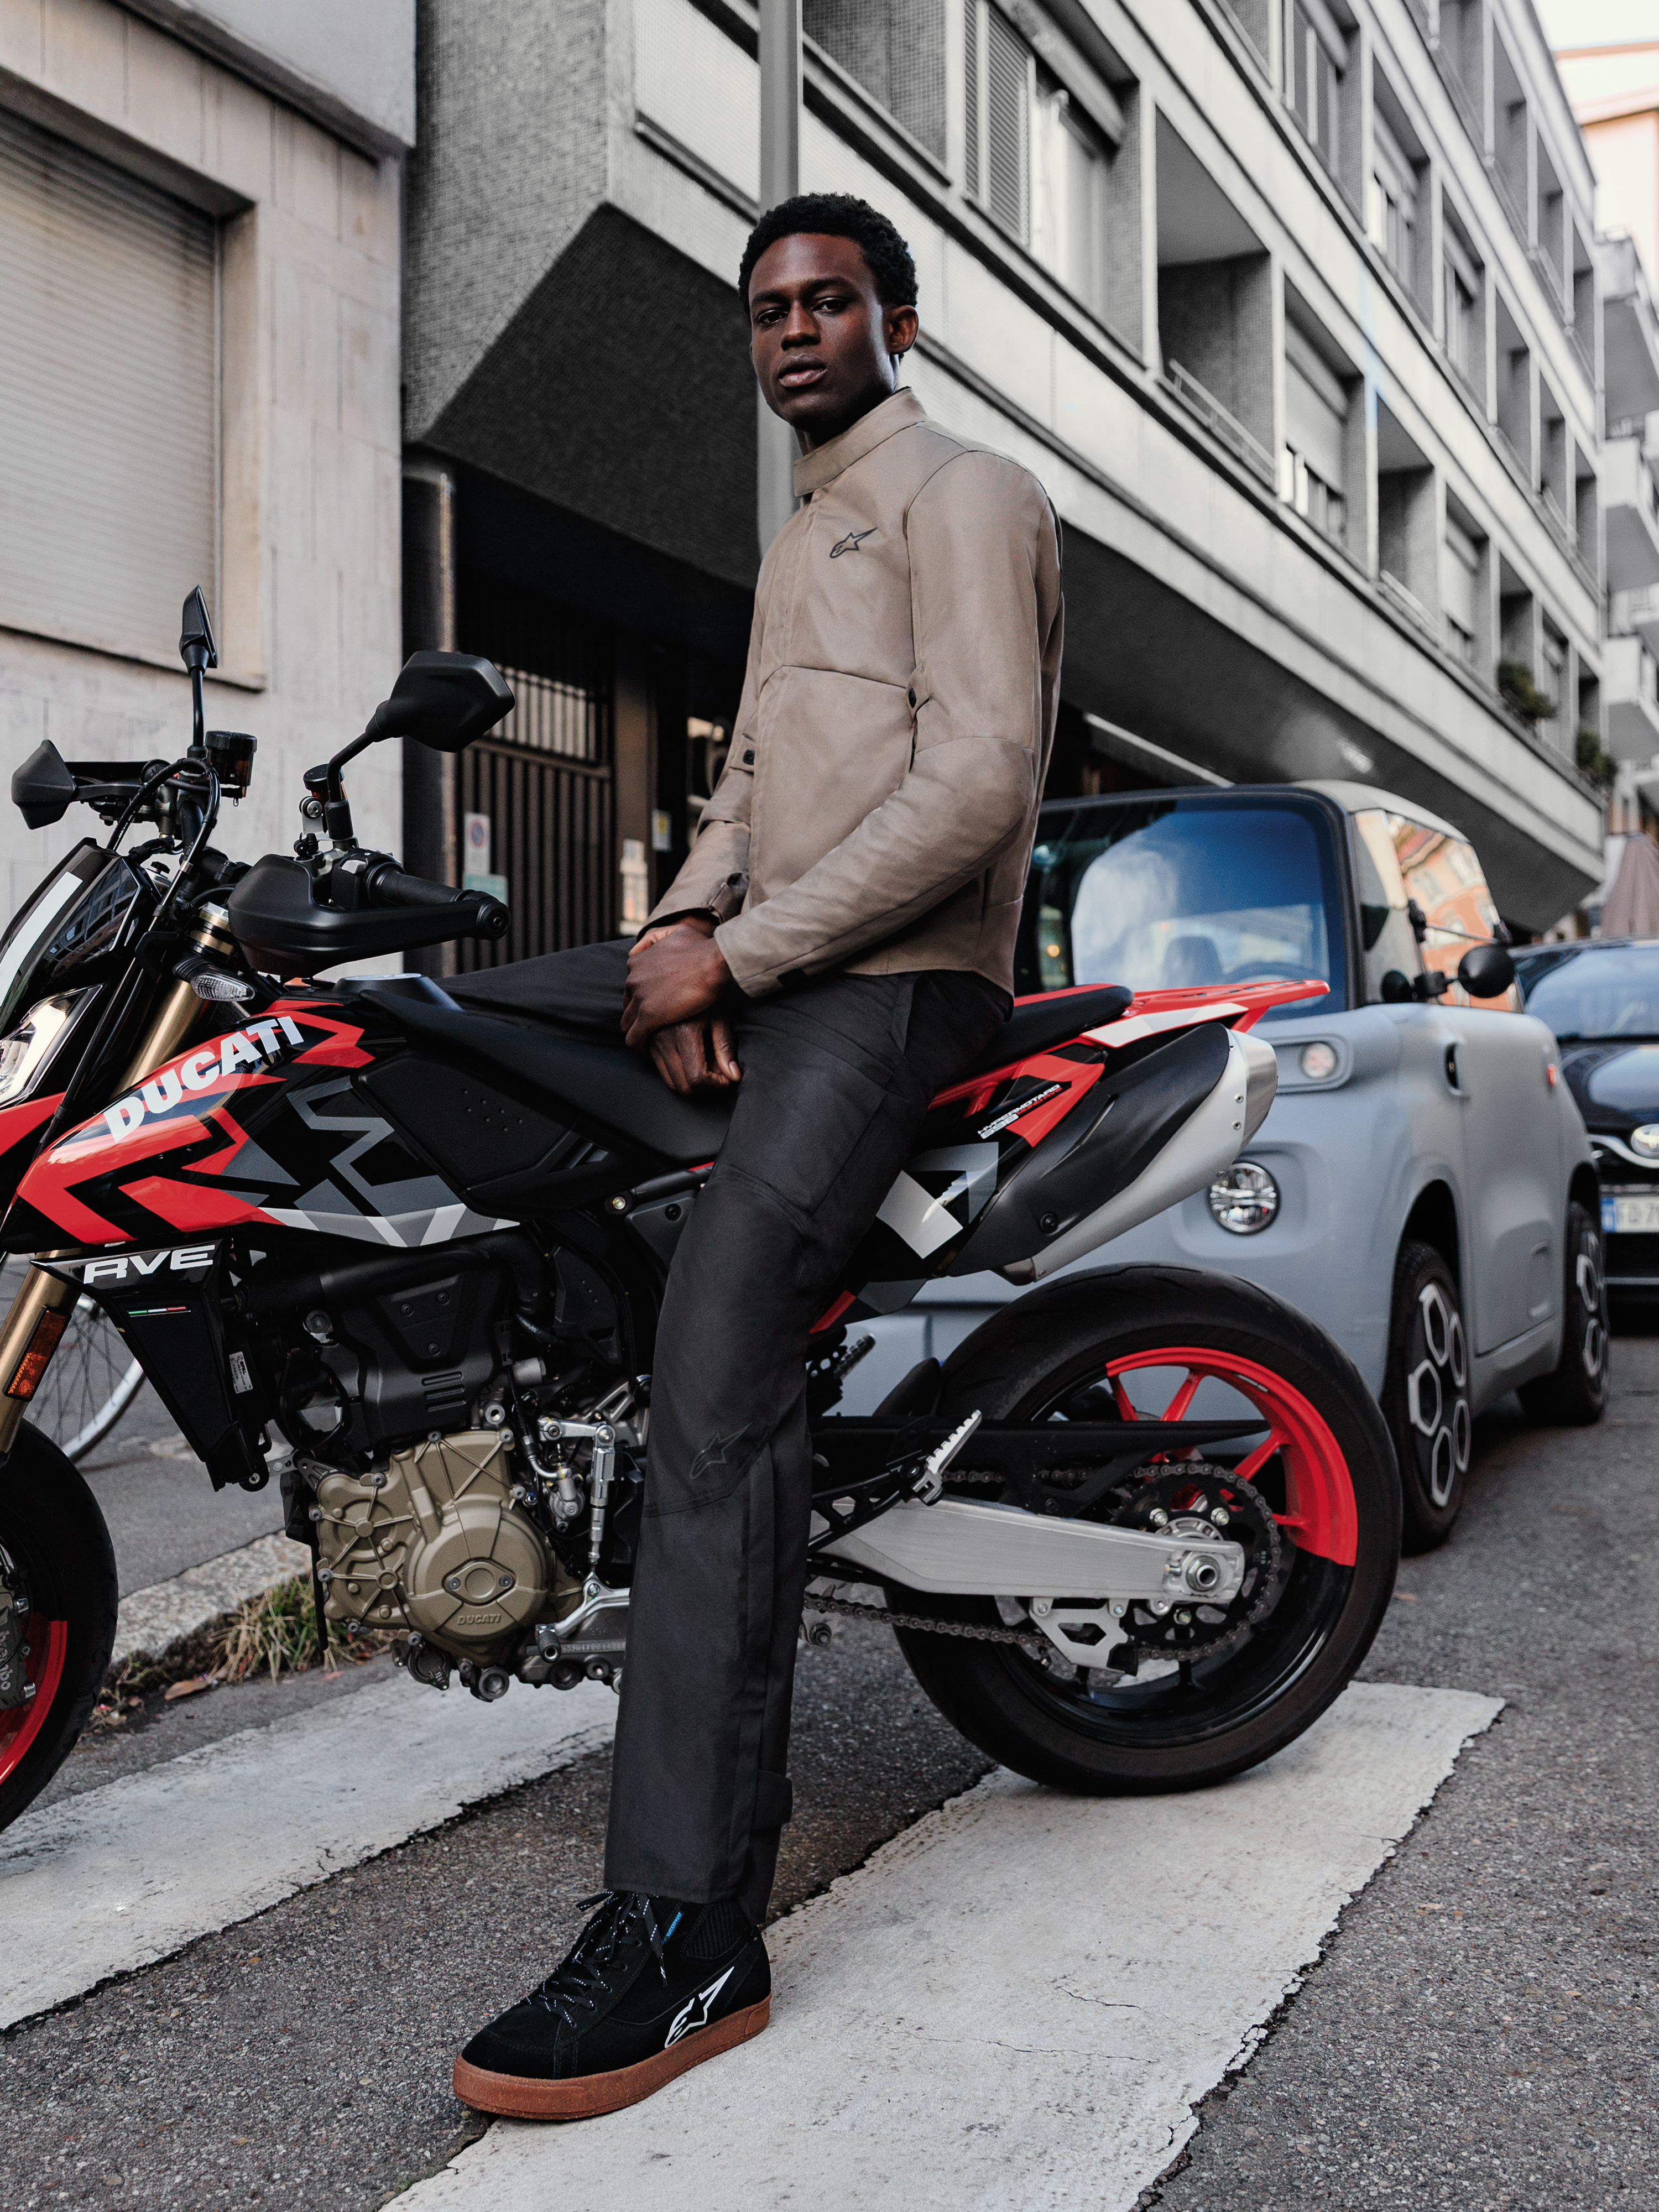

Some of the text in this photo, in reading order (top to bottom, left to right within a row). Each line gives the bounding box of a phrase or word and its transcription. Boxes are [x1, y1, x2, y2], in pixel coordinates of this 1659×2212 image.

[103, 1016, 304, 1142] DUCATI
[977, 1084, 1060, 1134] HYPERMOTARD
[980, 1113, 1019, 1139] 698
[84, 1245, 215, 1284] RVE
[458, 1614, 501, 1625] DUCATI
